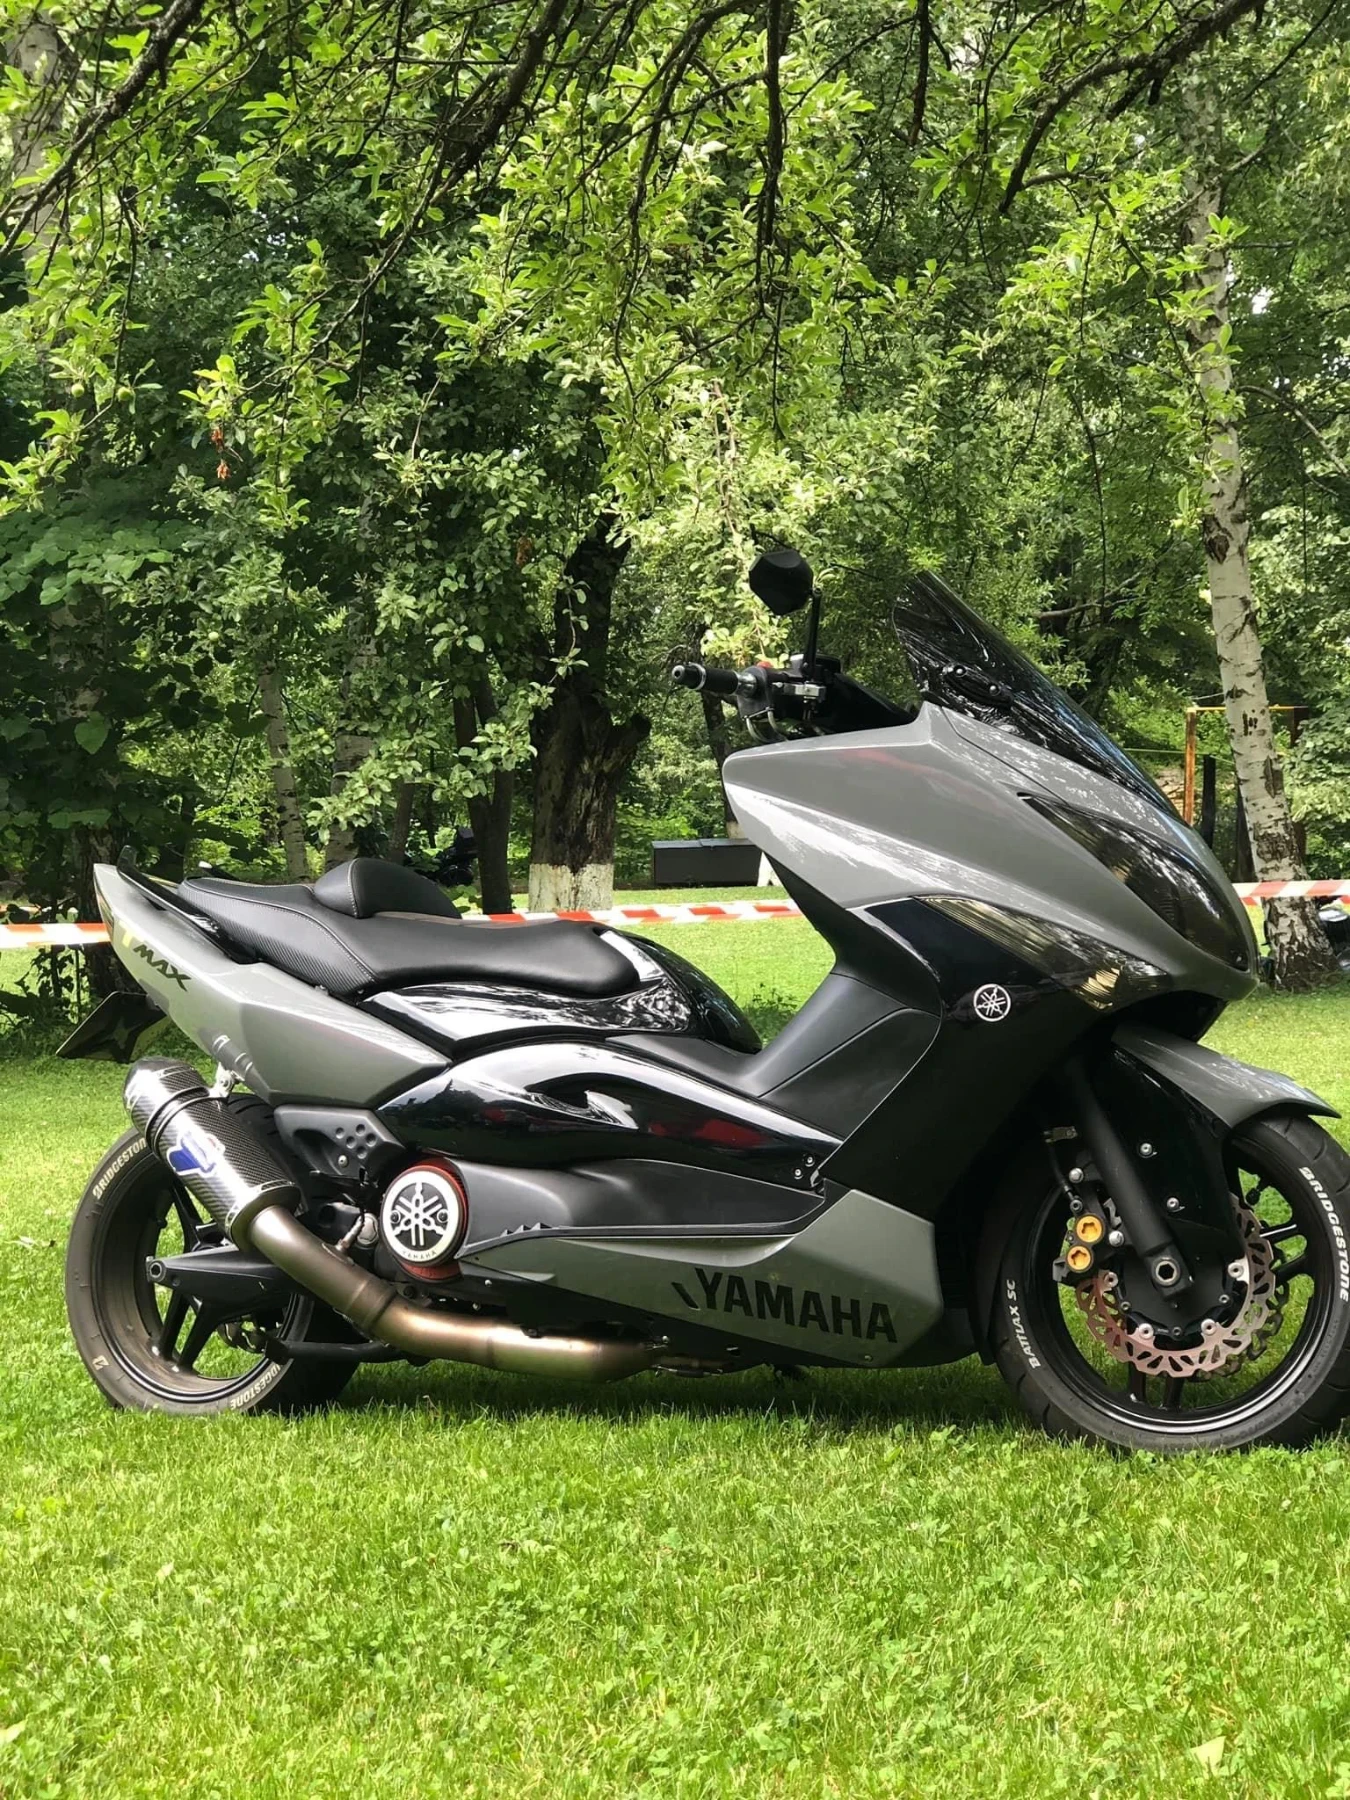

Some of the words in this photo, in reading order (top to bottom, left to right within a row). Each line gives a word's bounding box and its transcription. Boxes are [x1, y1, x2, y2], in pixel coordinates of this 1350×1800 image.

[92, 1137, 147, 1200] BRIDGESTON
[1299, 1166, 1350, 1302] BRIDGESTONE
[694, 1267, 898, 1344] YAMAHA
[1006, 1279, 1017, 1301] SC
[1008, 1305, 1041, 1369] BATTLAX
